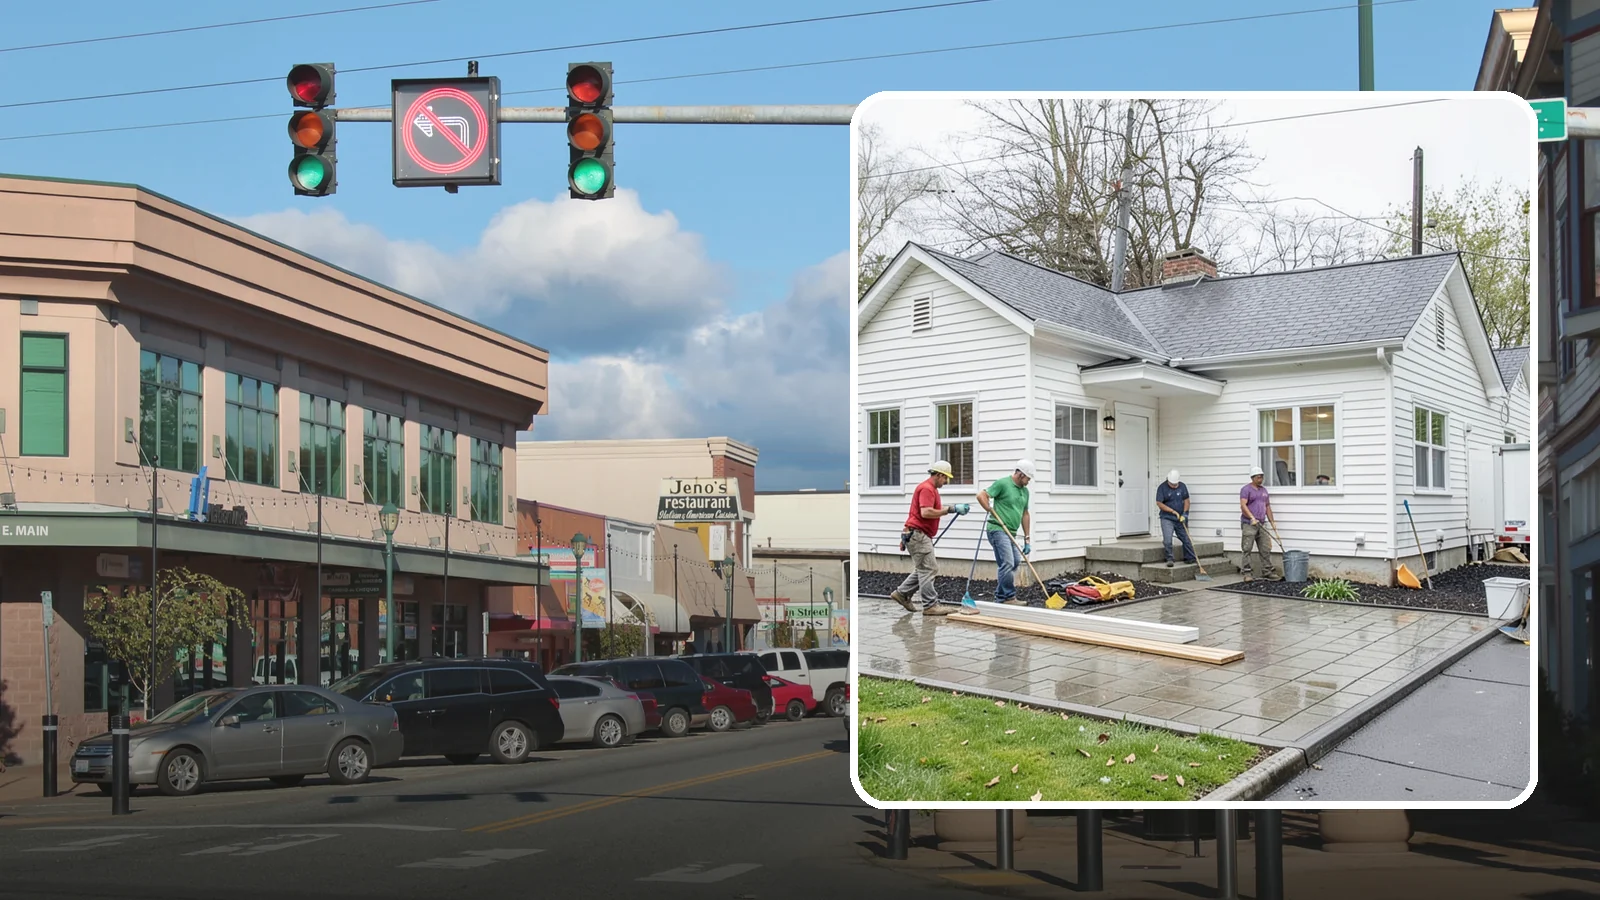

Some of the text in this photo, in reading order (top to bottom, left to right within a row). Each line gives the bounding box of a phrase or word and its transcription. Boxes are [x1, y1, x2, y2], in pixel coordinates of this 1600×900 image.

[670, 480, 727, 494] Jeno's
[665, 496, 731, 509] restaurant
[658, 510, 681, 519] Italian
[686, 509, 714, 519] American
[715, 509, 737, 519] Cuisine
[2, 525, 49, 536] E. MAIN
[797, 607, 828, 617] Street
[791, 619, 824, 627] lass
